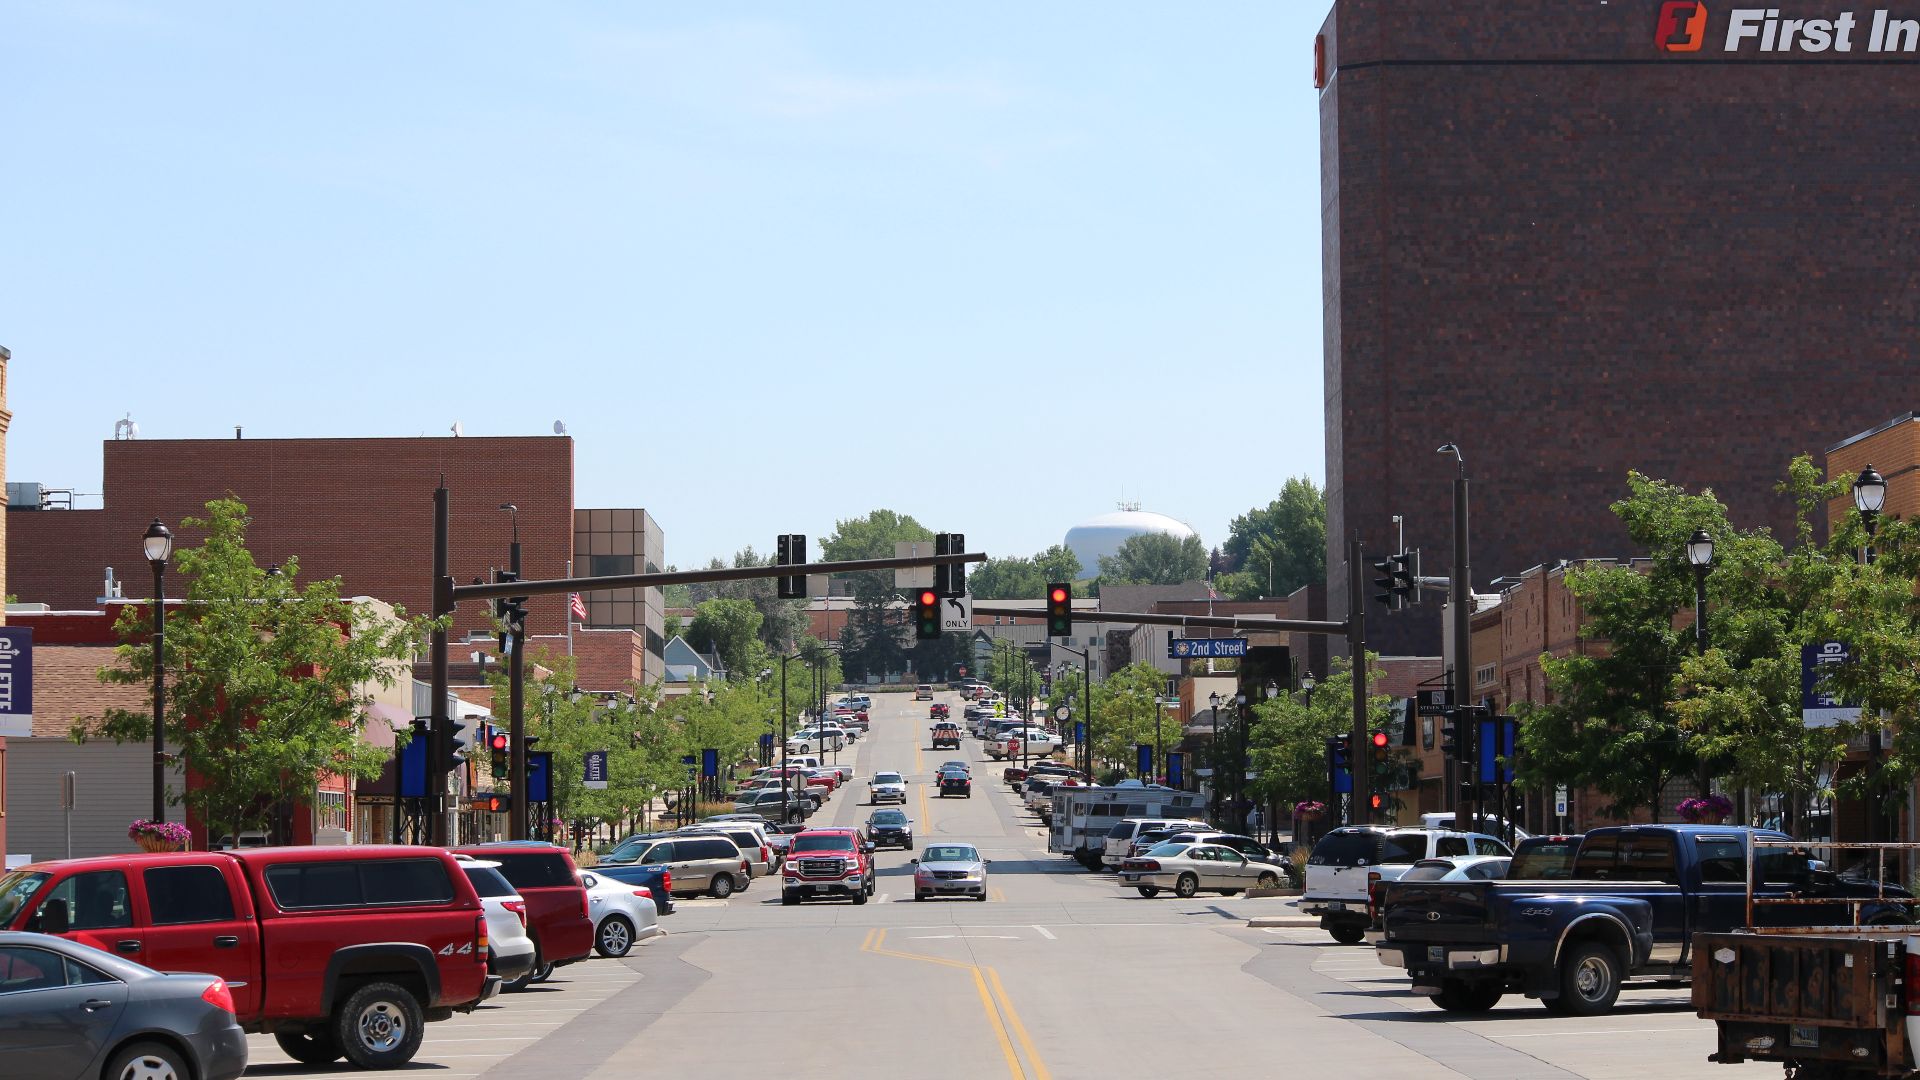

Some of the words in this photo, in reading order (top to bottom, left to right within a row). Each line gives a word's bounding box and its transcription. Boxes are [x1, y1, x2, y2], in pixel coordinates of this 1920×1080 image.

[1724, 9, 1856, 52] First
[945, 620, 968, 628] ONLY
[1191, 641, 1210, 656] 2nd
[1214, 641, 1244, 655] Street
